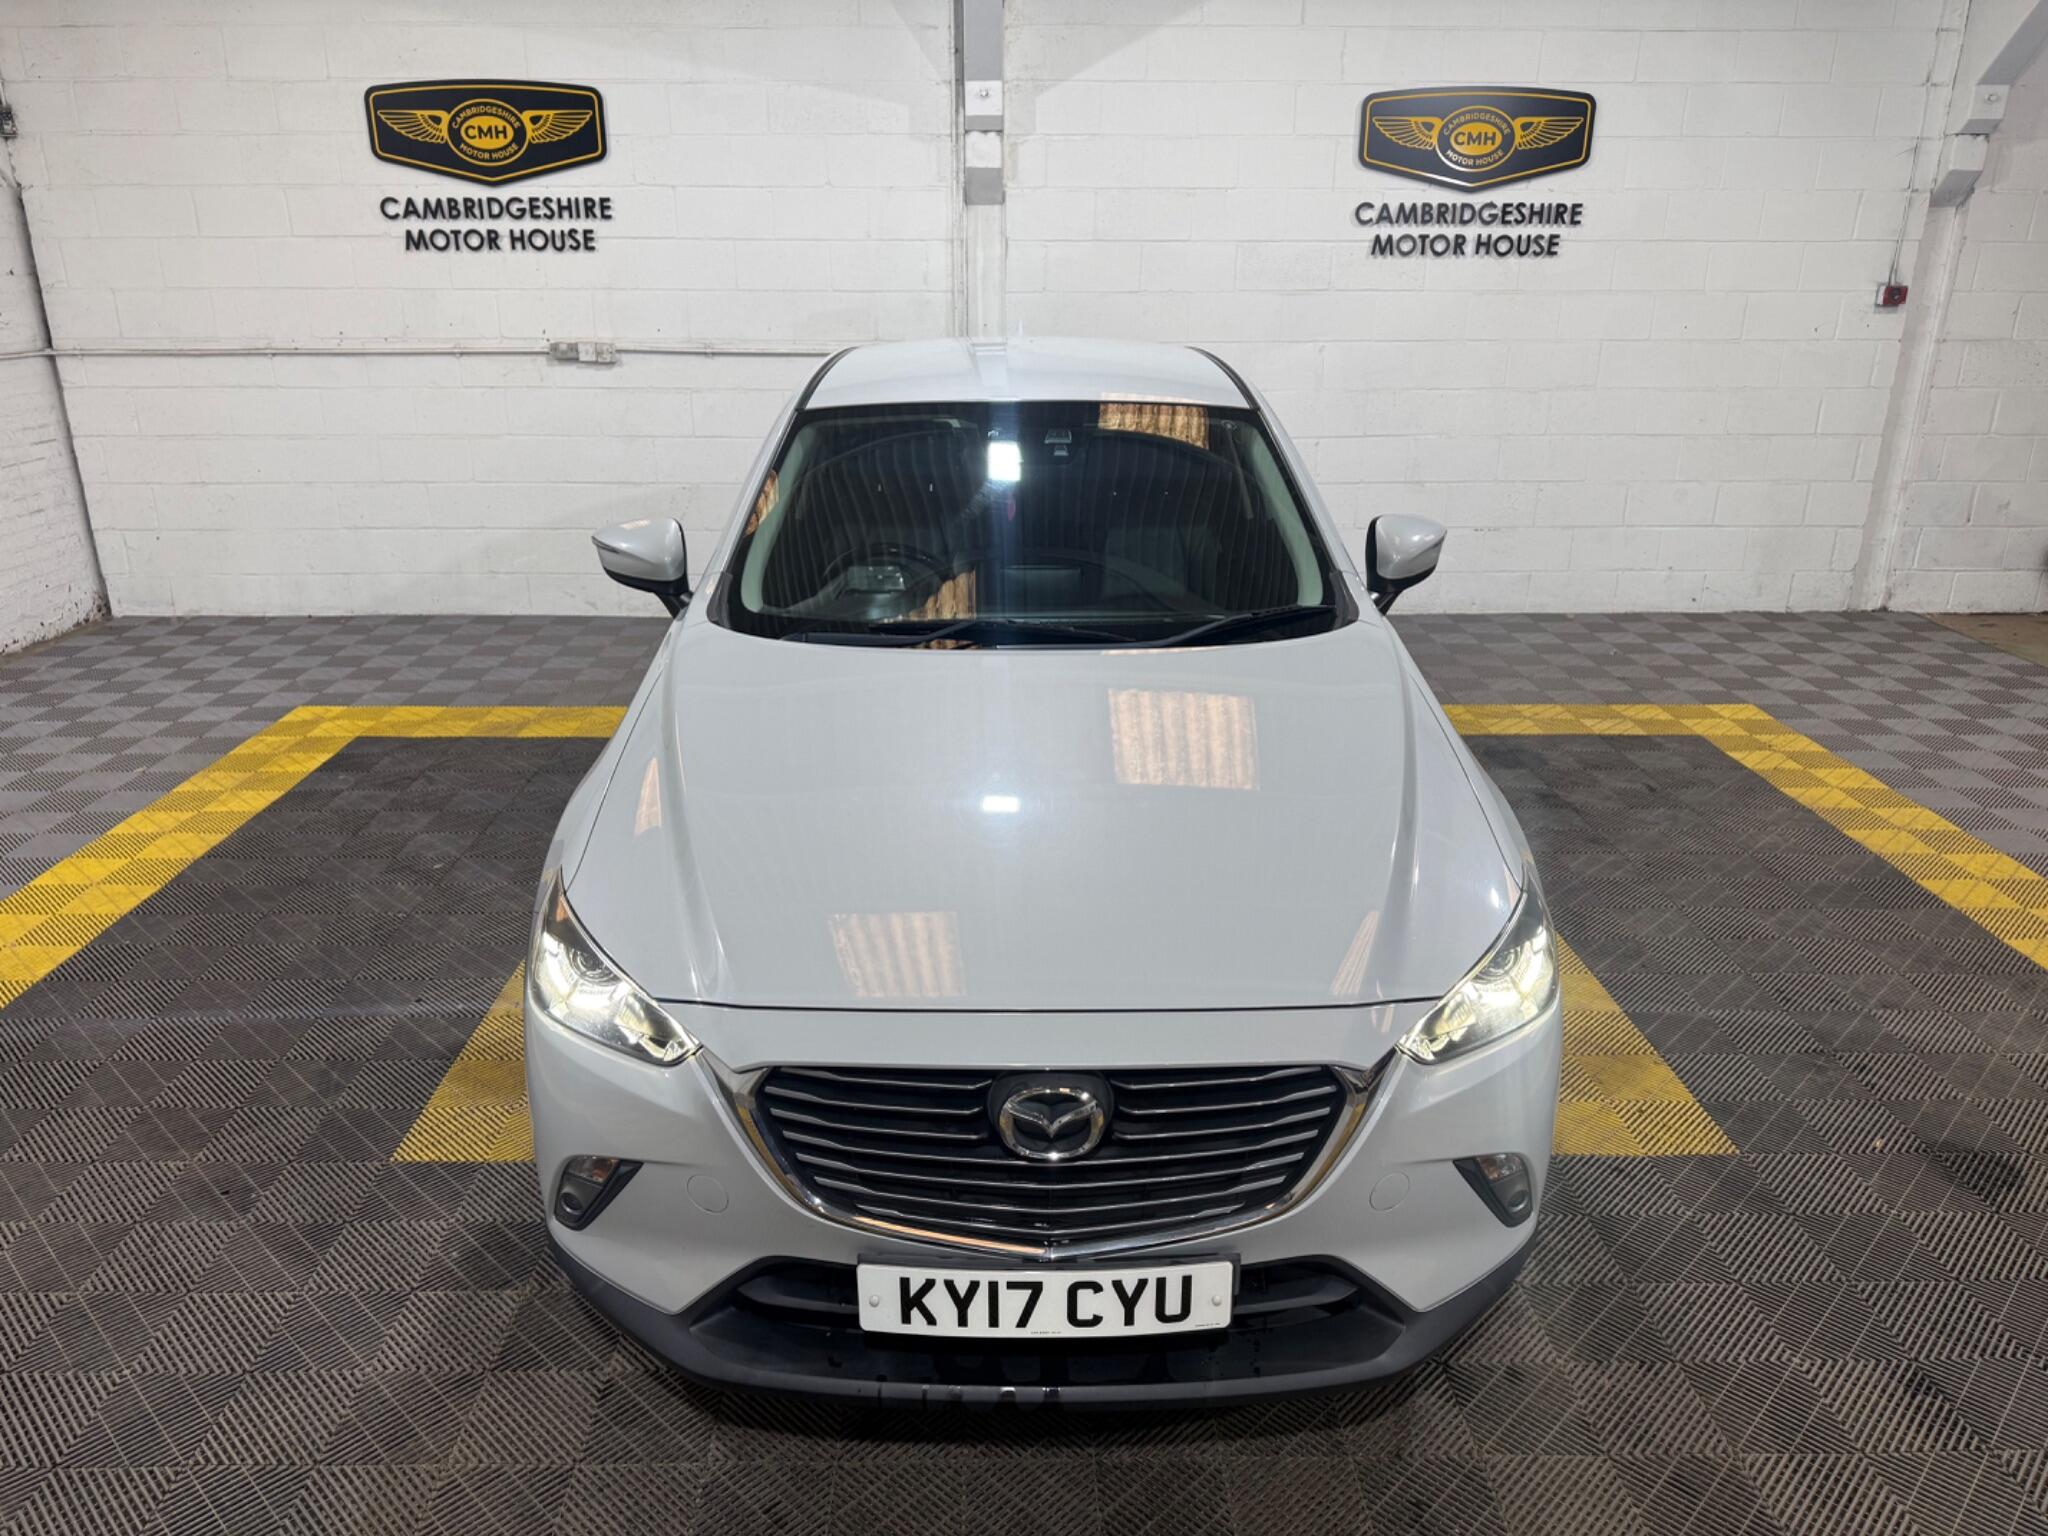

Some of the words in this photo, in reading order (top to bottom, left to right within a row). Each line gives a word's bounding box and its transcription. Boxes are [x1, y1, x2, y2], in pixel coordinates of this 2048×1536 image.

[452, 105, 520, 129] CAMBRIDGESHIRE
[1443, 112, 1511, 136] CAMBRIDGESHIRE
[464, 125, 508, 140] CMH
[1453, 131, 1497, 146] CMH
[459, 143, 491, 160] MOTOR
[491, 142, 519, 160] HOUSE
[1444, 149, 1474, 167] MOTOR
[1475, 149, 1505, 166] HOUSE
[379, 197, 612, 220] CAMBRIDGESHIRE
[1354, 202, 1584, 226] CAMBRIDGESHIRE
[405, 228, 502, 252] MOTOR
[509, 228, 596, 252] HOUSE
[1370, 233, 1467, 257] MOTOR
[1474, 233, 1561, 257] HOUSE
[899, 1276, 1044, 1329] KY17
[1066, 1274, 1193, 1329] CYU
